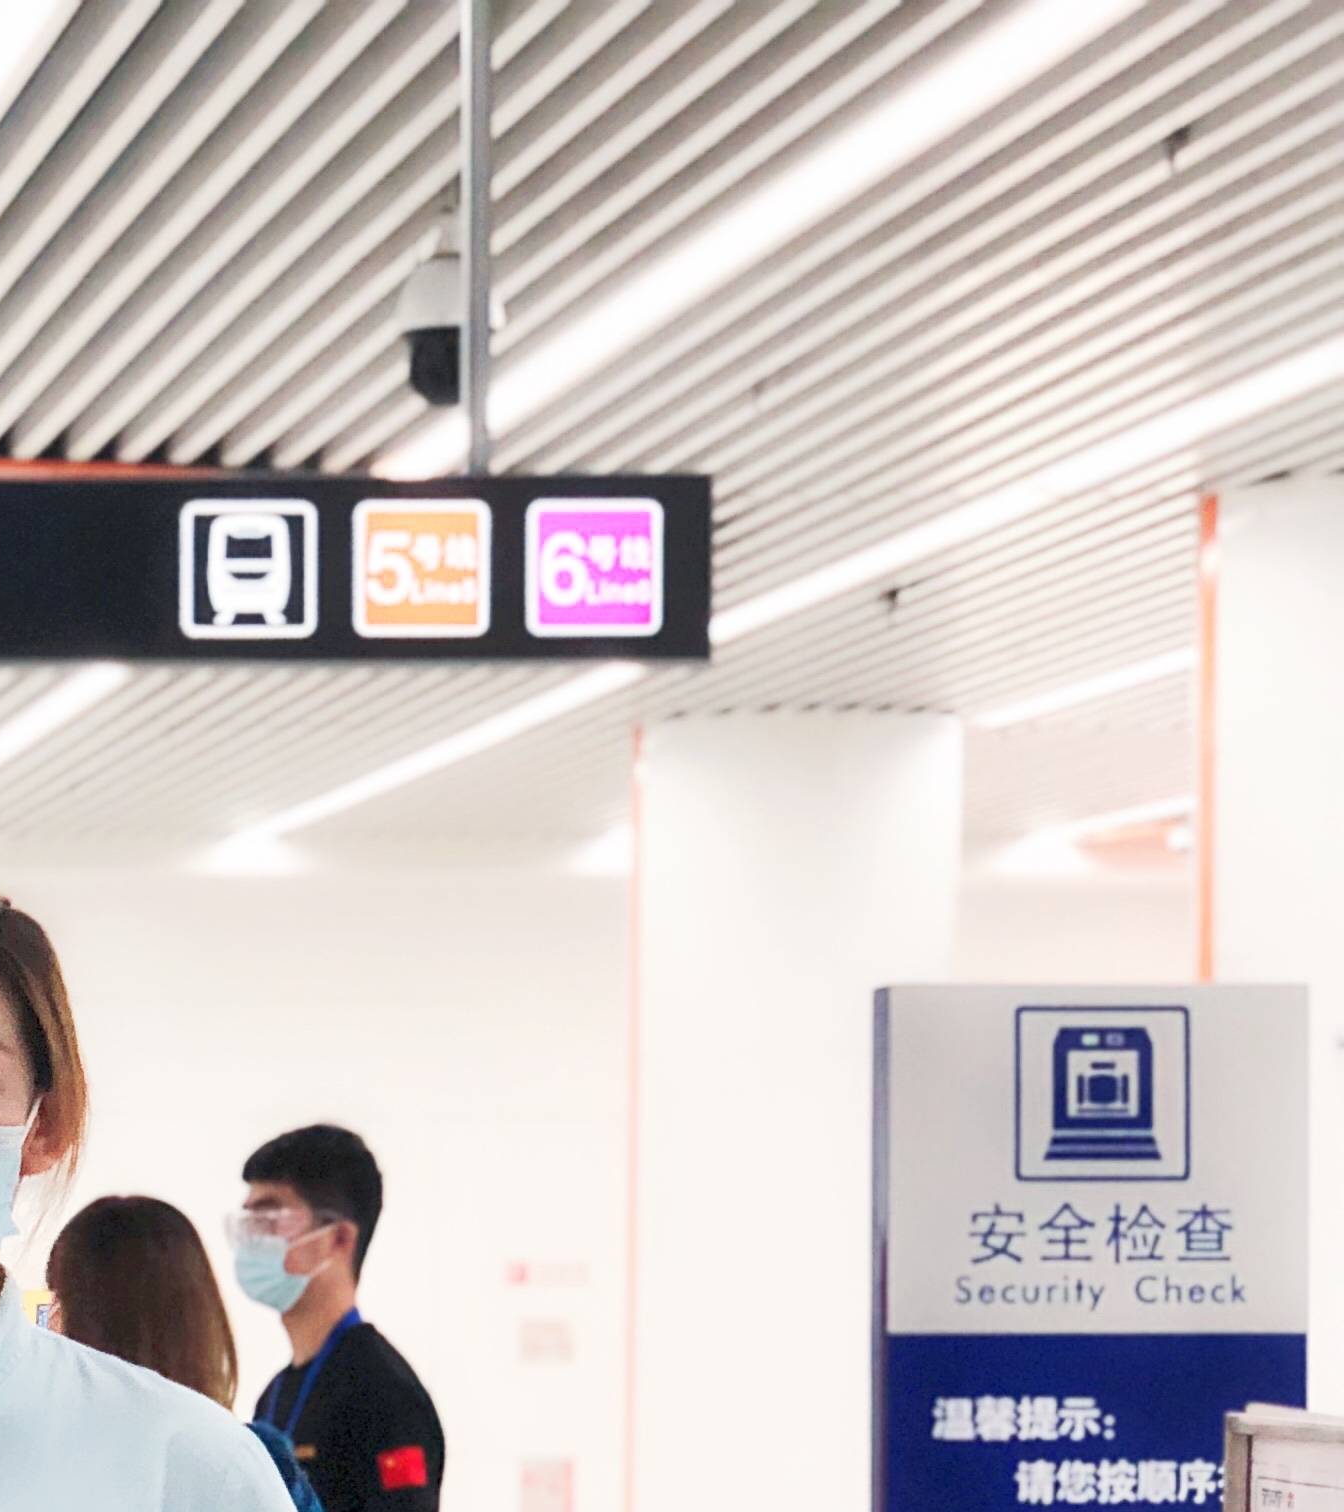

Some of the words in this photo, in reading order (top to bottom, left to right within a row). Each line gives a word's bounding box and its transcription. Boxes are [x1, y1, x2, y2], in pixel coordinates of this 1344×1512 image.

[969, 1203, 1233, 1264] 安全检查
[955, 1275, 1105, 1311] Security
[1135, 1275, 1246, 1304] Check
[1014, 1458, 1224, 1505] 请您按顺序
